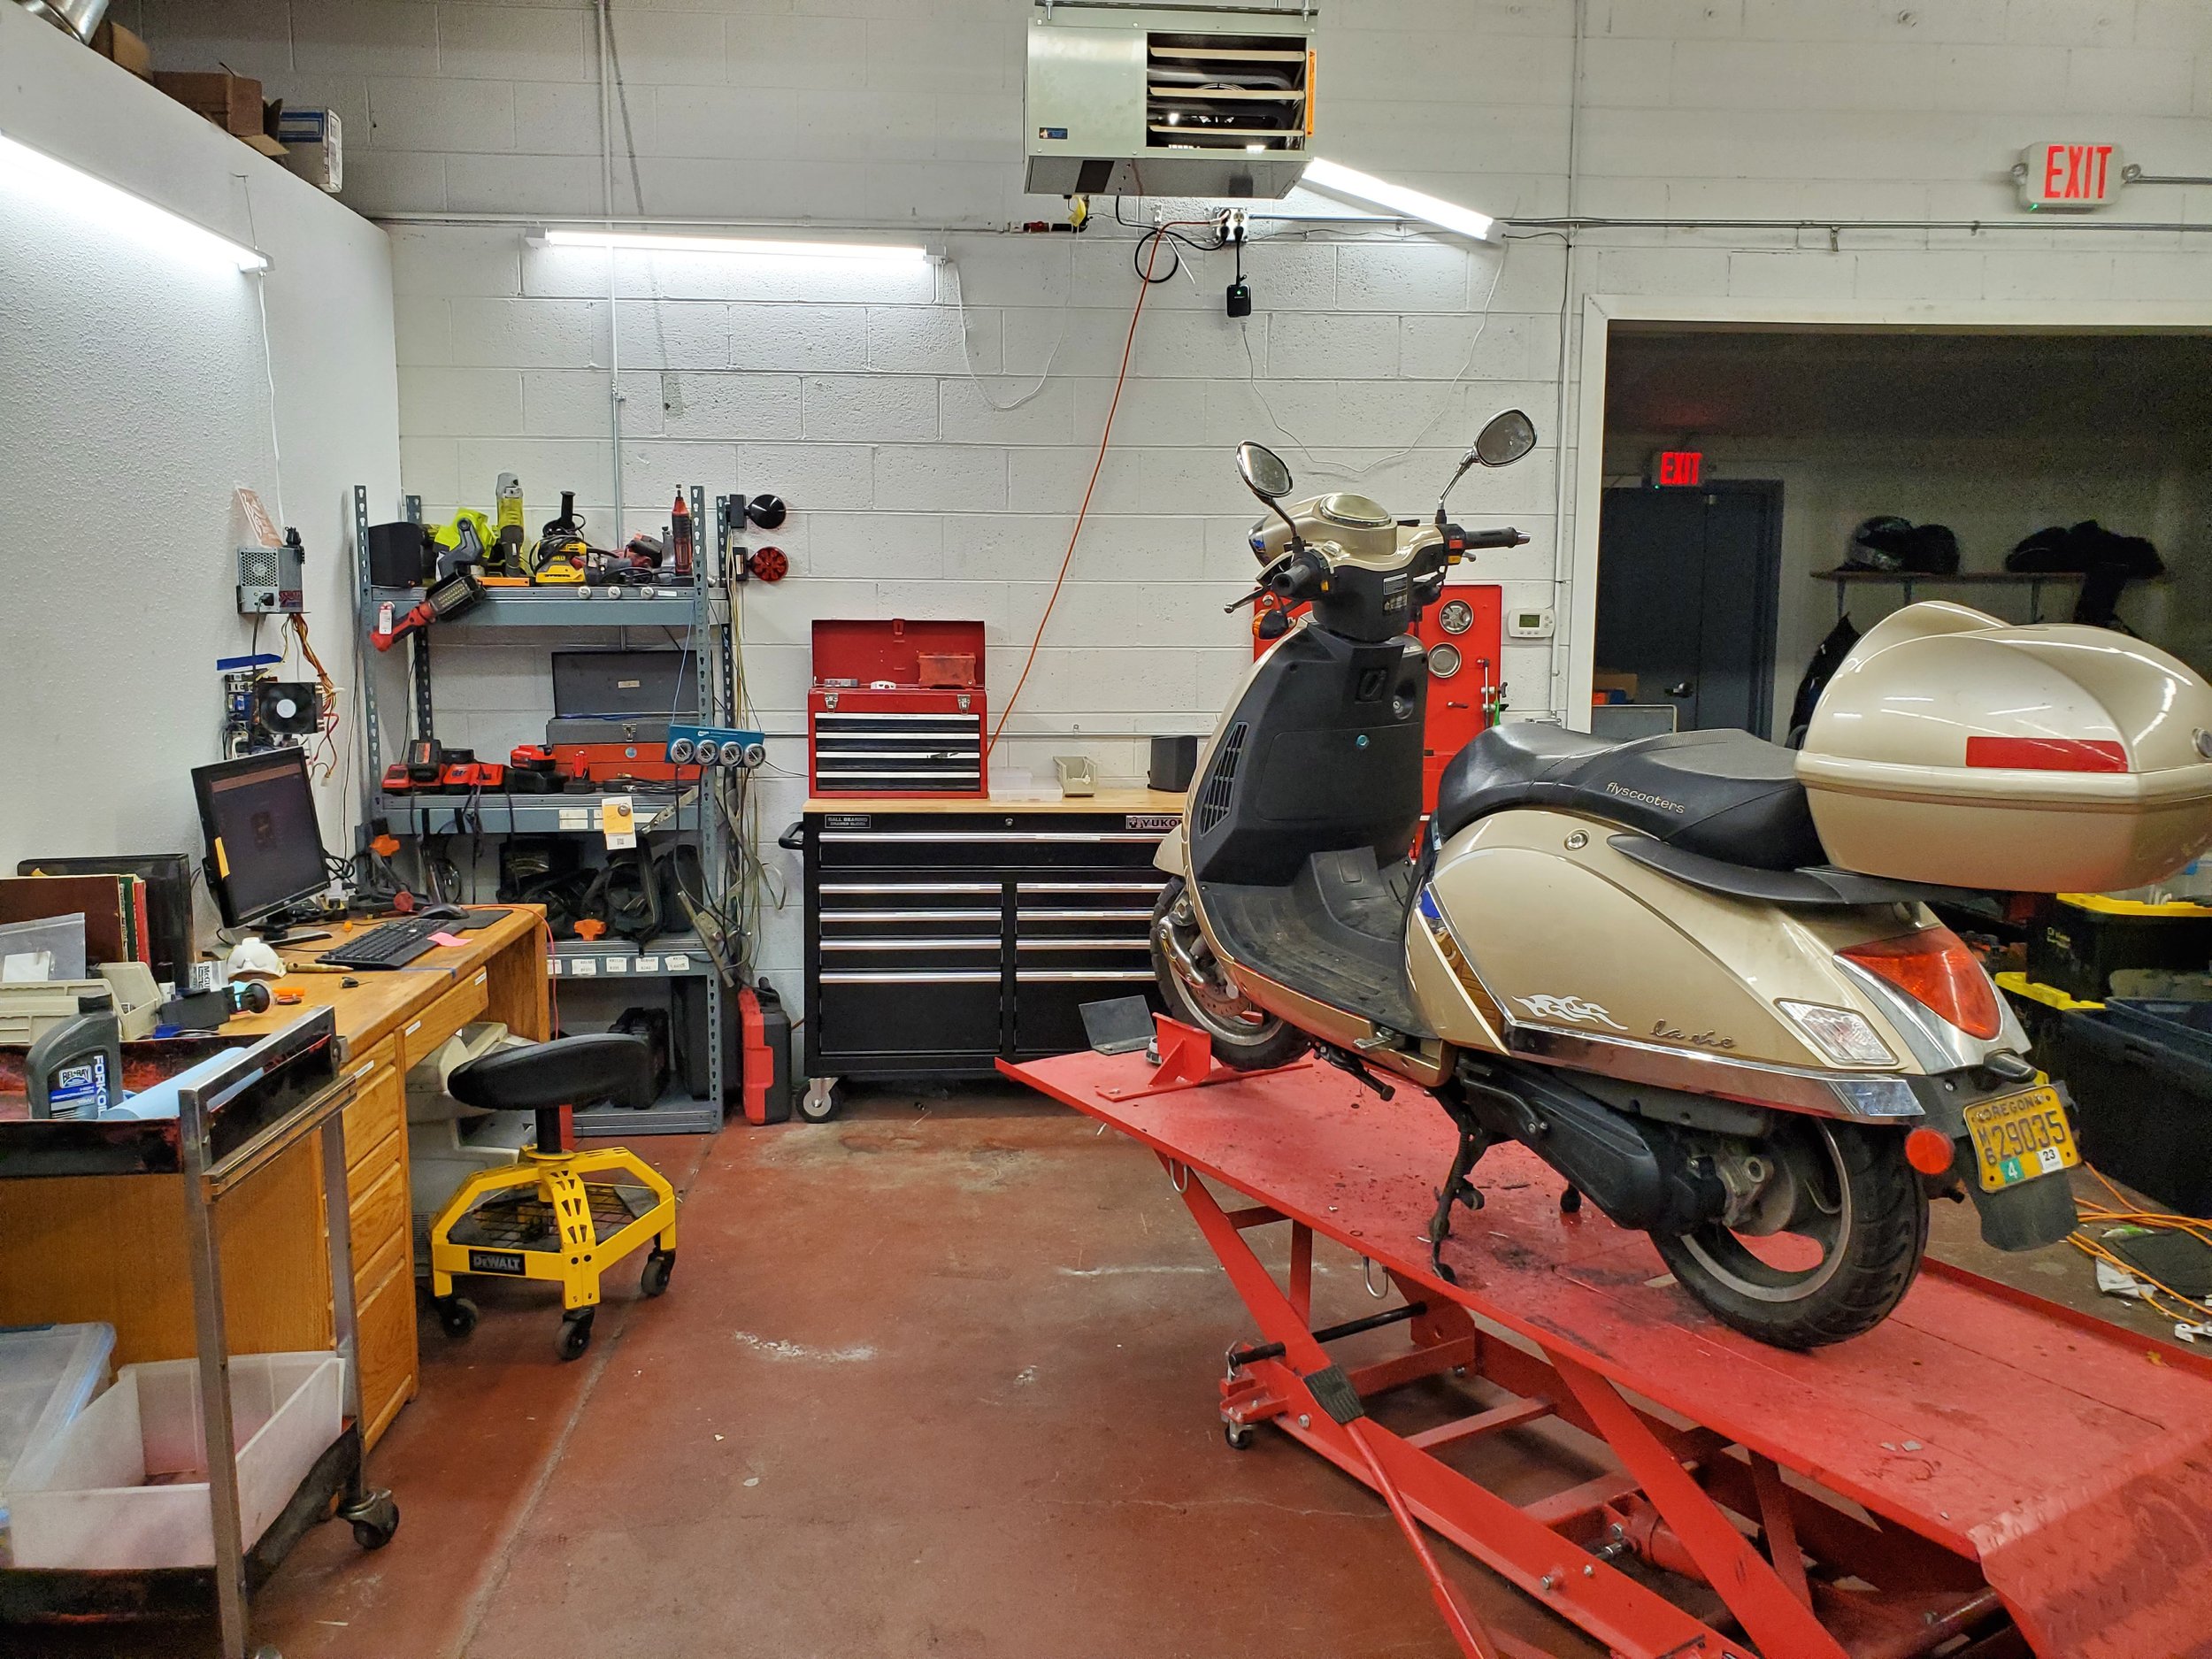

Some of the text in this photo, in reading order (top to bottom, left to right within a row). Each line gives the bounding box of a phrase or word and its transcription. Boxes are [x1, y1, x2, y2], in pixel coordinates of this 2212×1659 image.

[2044, 145, 2113, 199] EXIT
[1660, 452, 1702, 485] EXIT
[1605, 781, 1686, 814] flyscooters
[94, 1055, 106, 1094] FORK
[1983, 1096, 2034, 1121] OREGON
[1992, 1110, 2066, 1160] 29035
[2008, 1161, 2018, 1179] 4
[2042, 1149, 2056, 1161] 23
